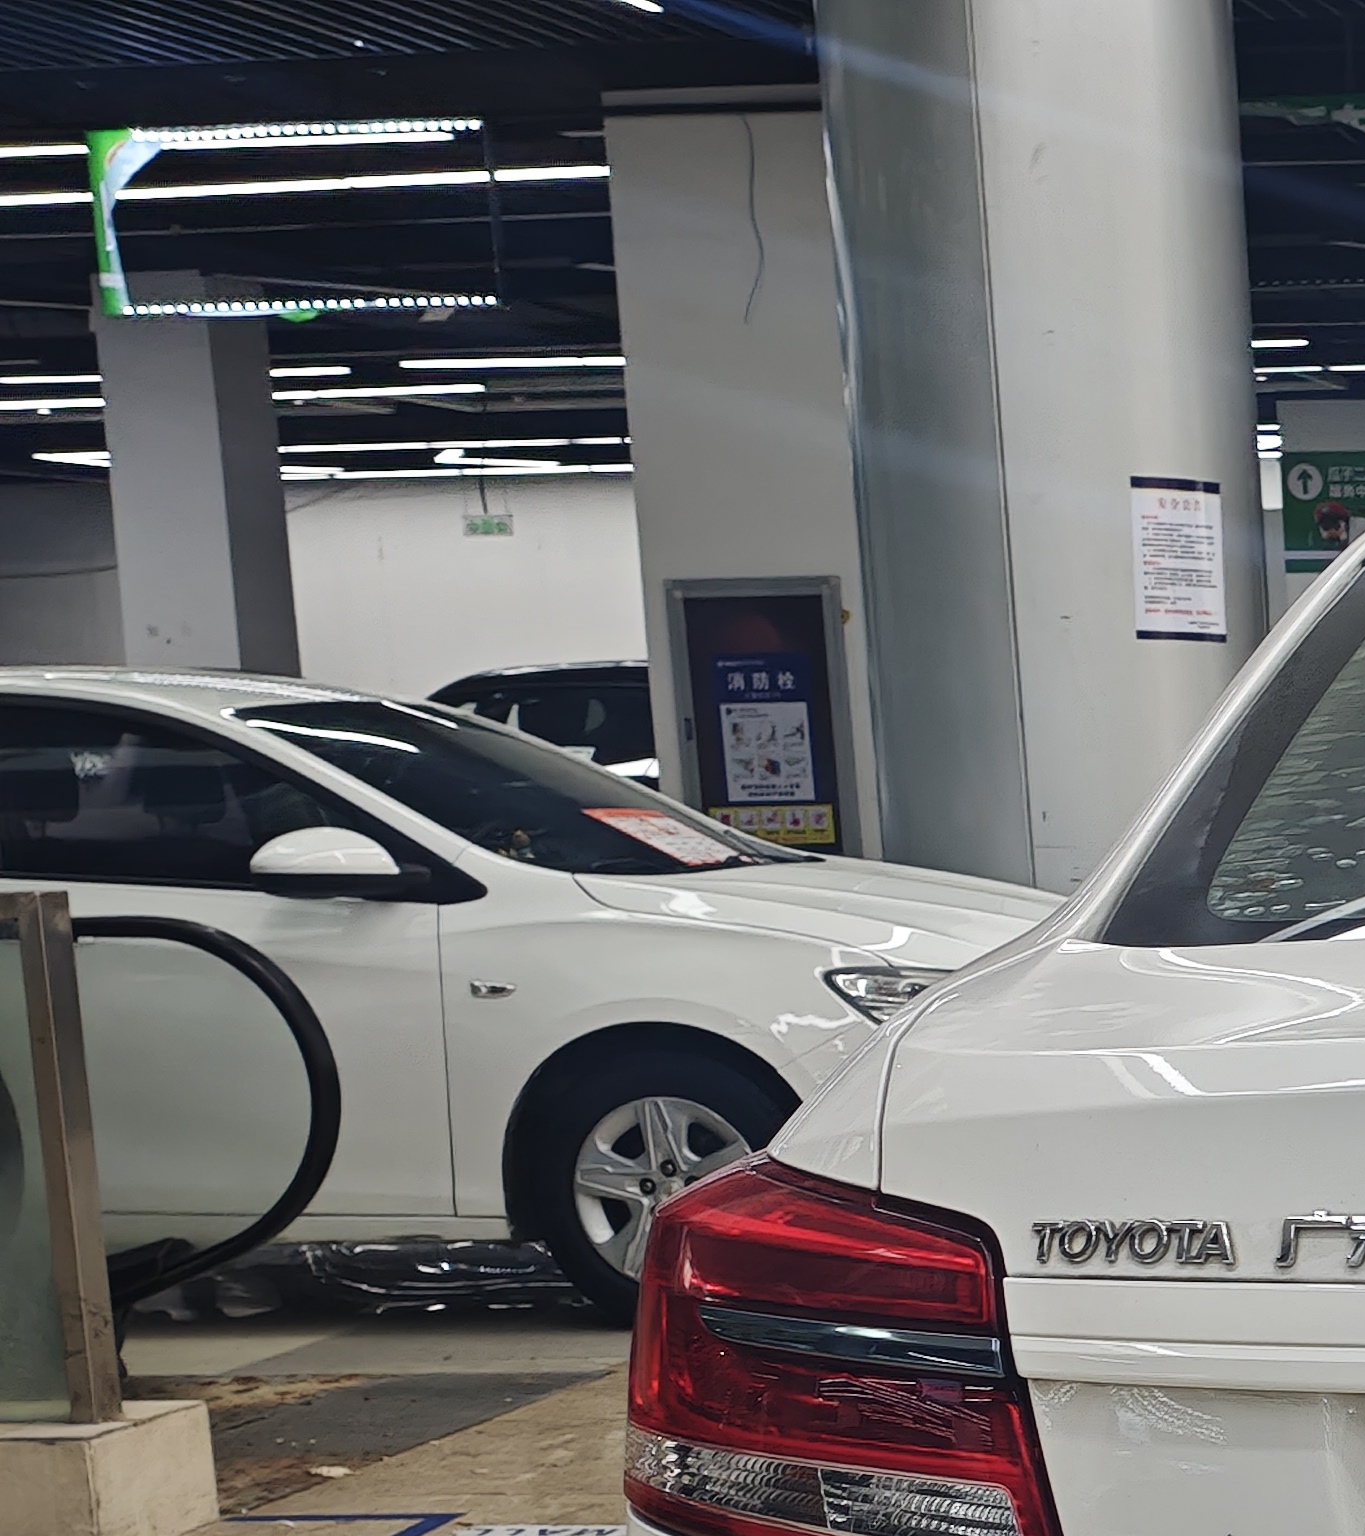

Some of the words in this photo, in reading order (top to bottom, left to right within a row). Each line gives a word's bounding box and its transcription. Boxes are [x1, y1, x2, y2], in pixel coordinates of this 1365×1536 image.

[727, 671, 796, 691] 消防栓
[1032, 1219, 1237, 1267] TOYOTA
